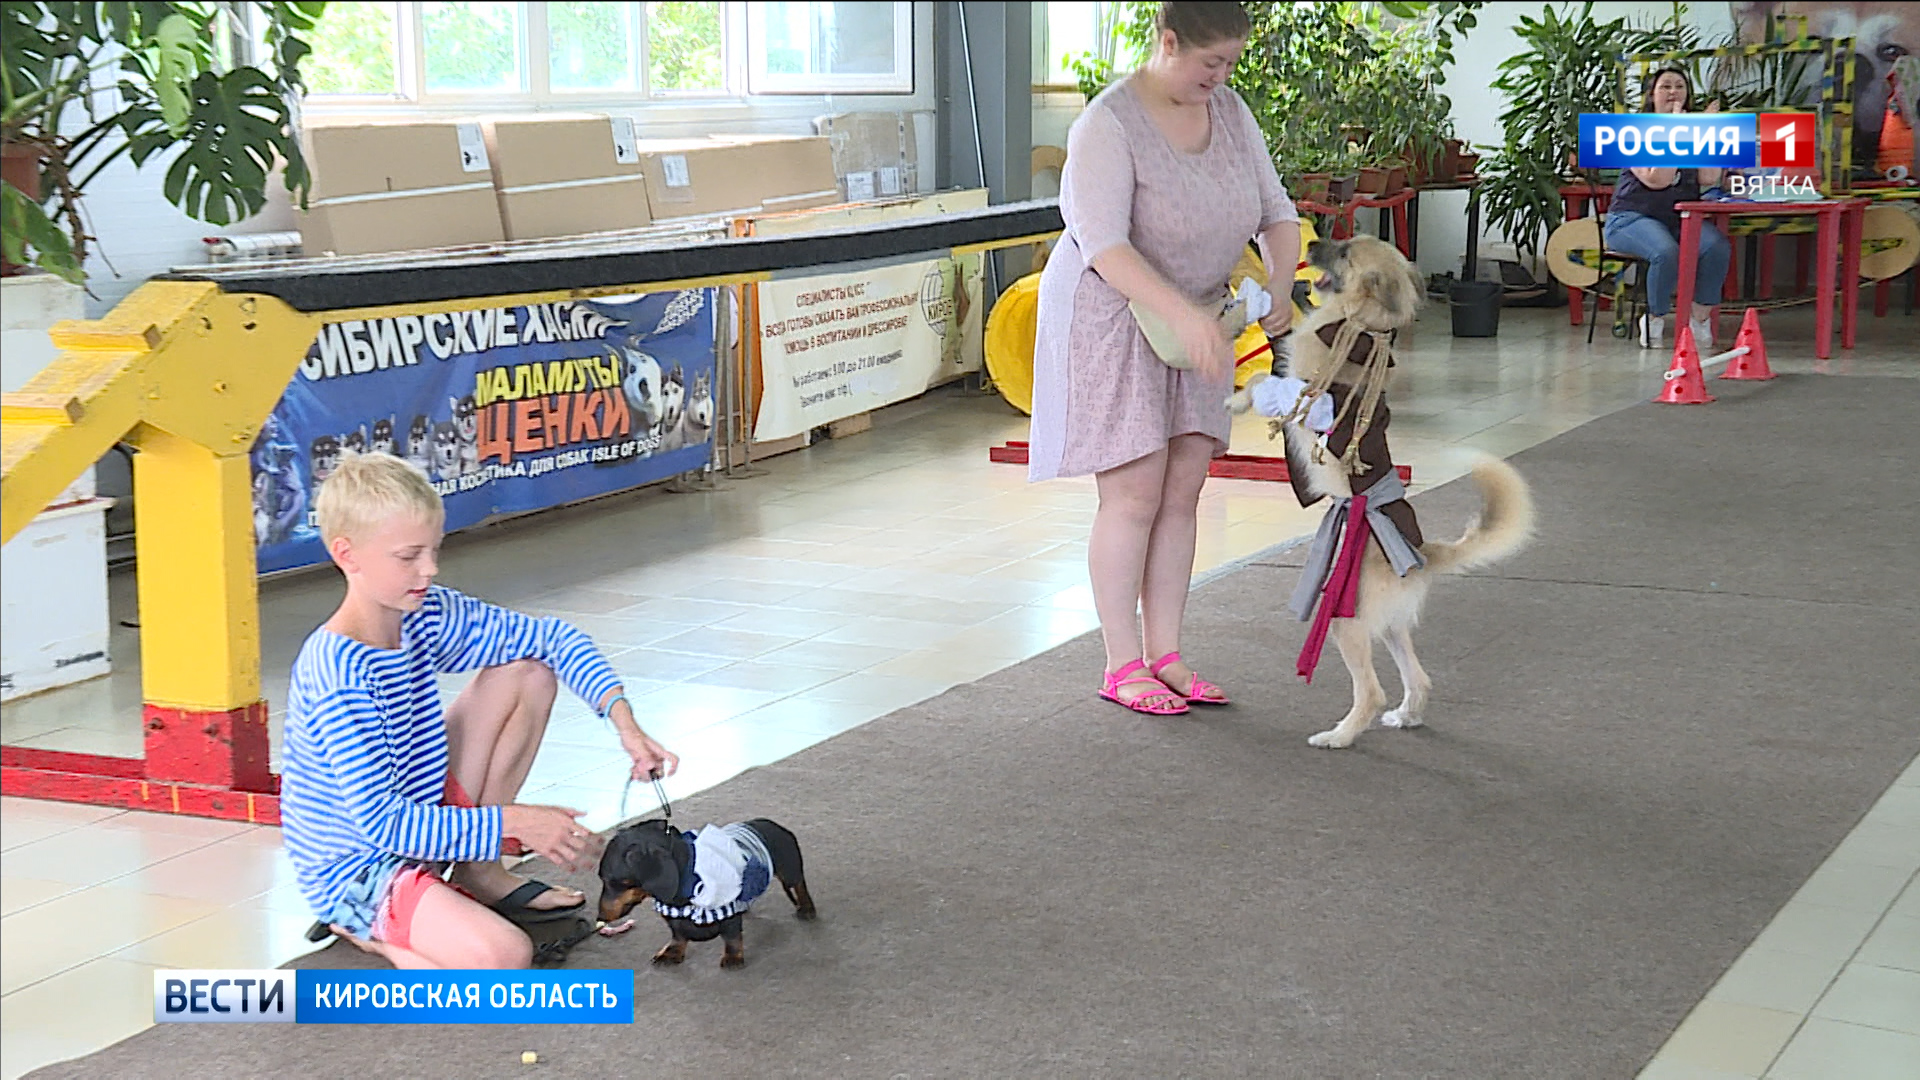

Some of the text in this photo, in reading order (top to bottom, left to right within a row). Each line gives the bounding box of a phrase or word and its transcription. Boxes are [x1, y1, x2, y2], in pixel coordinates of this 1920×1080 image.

[299, 307, 518, 381] СИБИРСКИЕ
[476, 354, 621, 408] МАЛАМУТЫ
[477, 389, 631, 465] ЩЕНКИ
[591, 444, 620, 463] ISLE
[620, 440, 636, 458] OF
